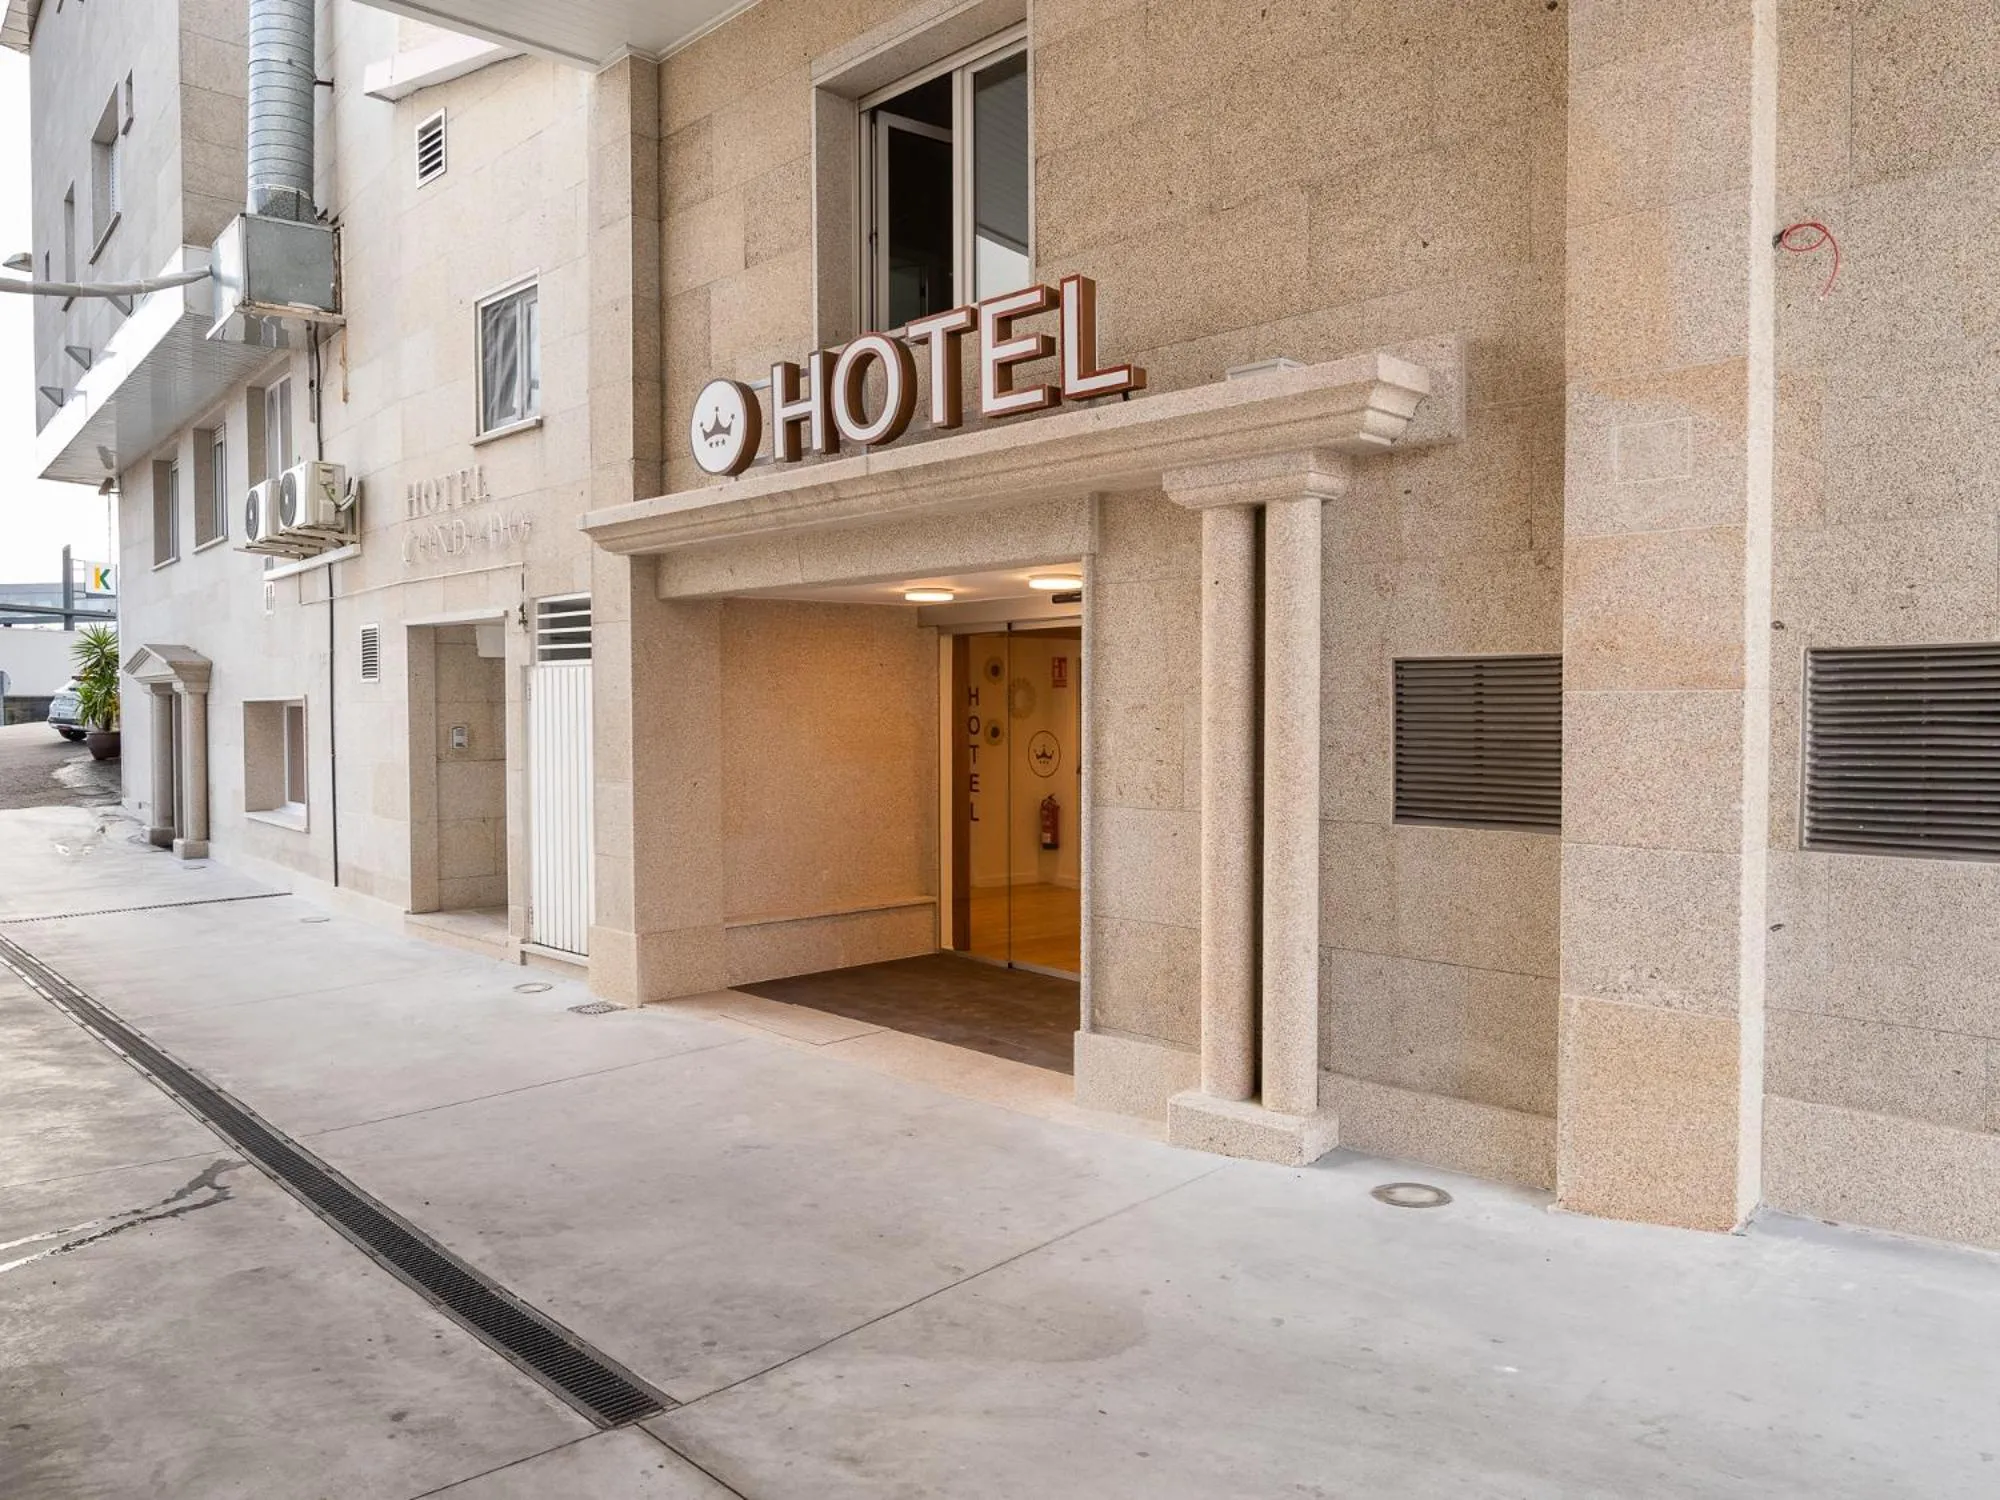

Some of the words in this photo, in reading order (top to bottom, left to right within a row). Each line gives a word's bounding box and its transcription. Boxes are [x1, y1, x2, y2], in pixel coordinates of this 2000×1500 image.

[771, 273, 1147, 463] HOTEL
[406, 464, 491, 518] HOTEL
[95, 567, 111, 590] K
[967, 686, 981, 822] HOTEL
